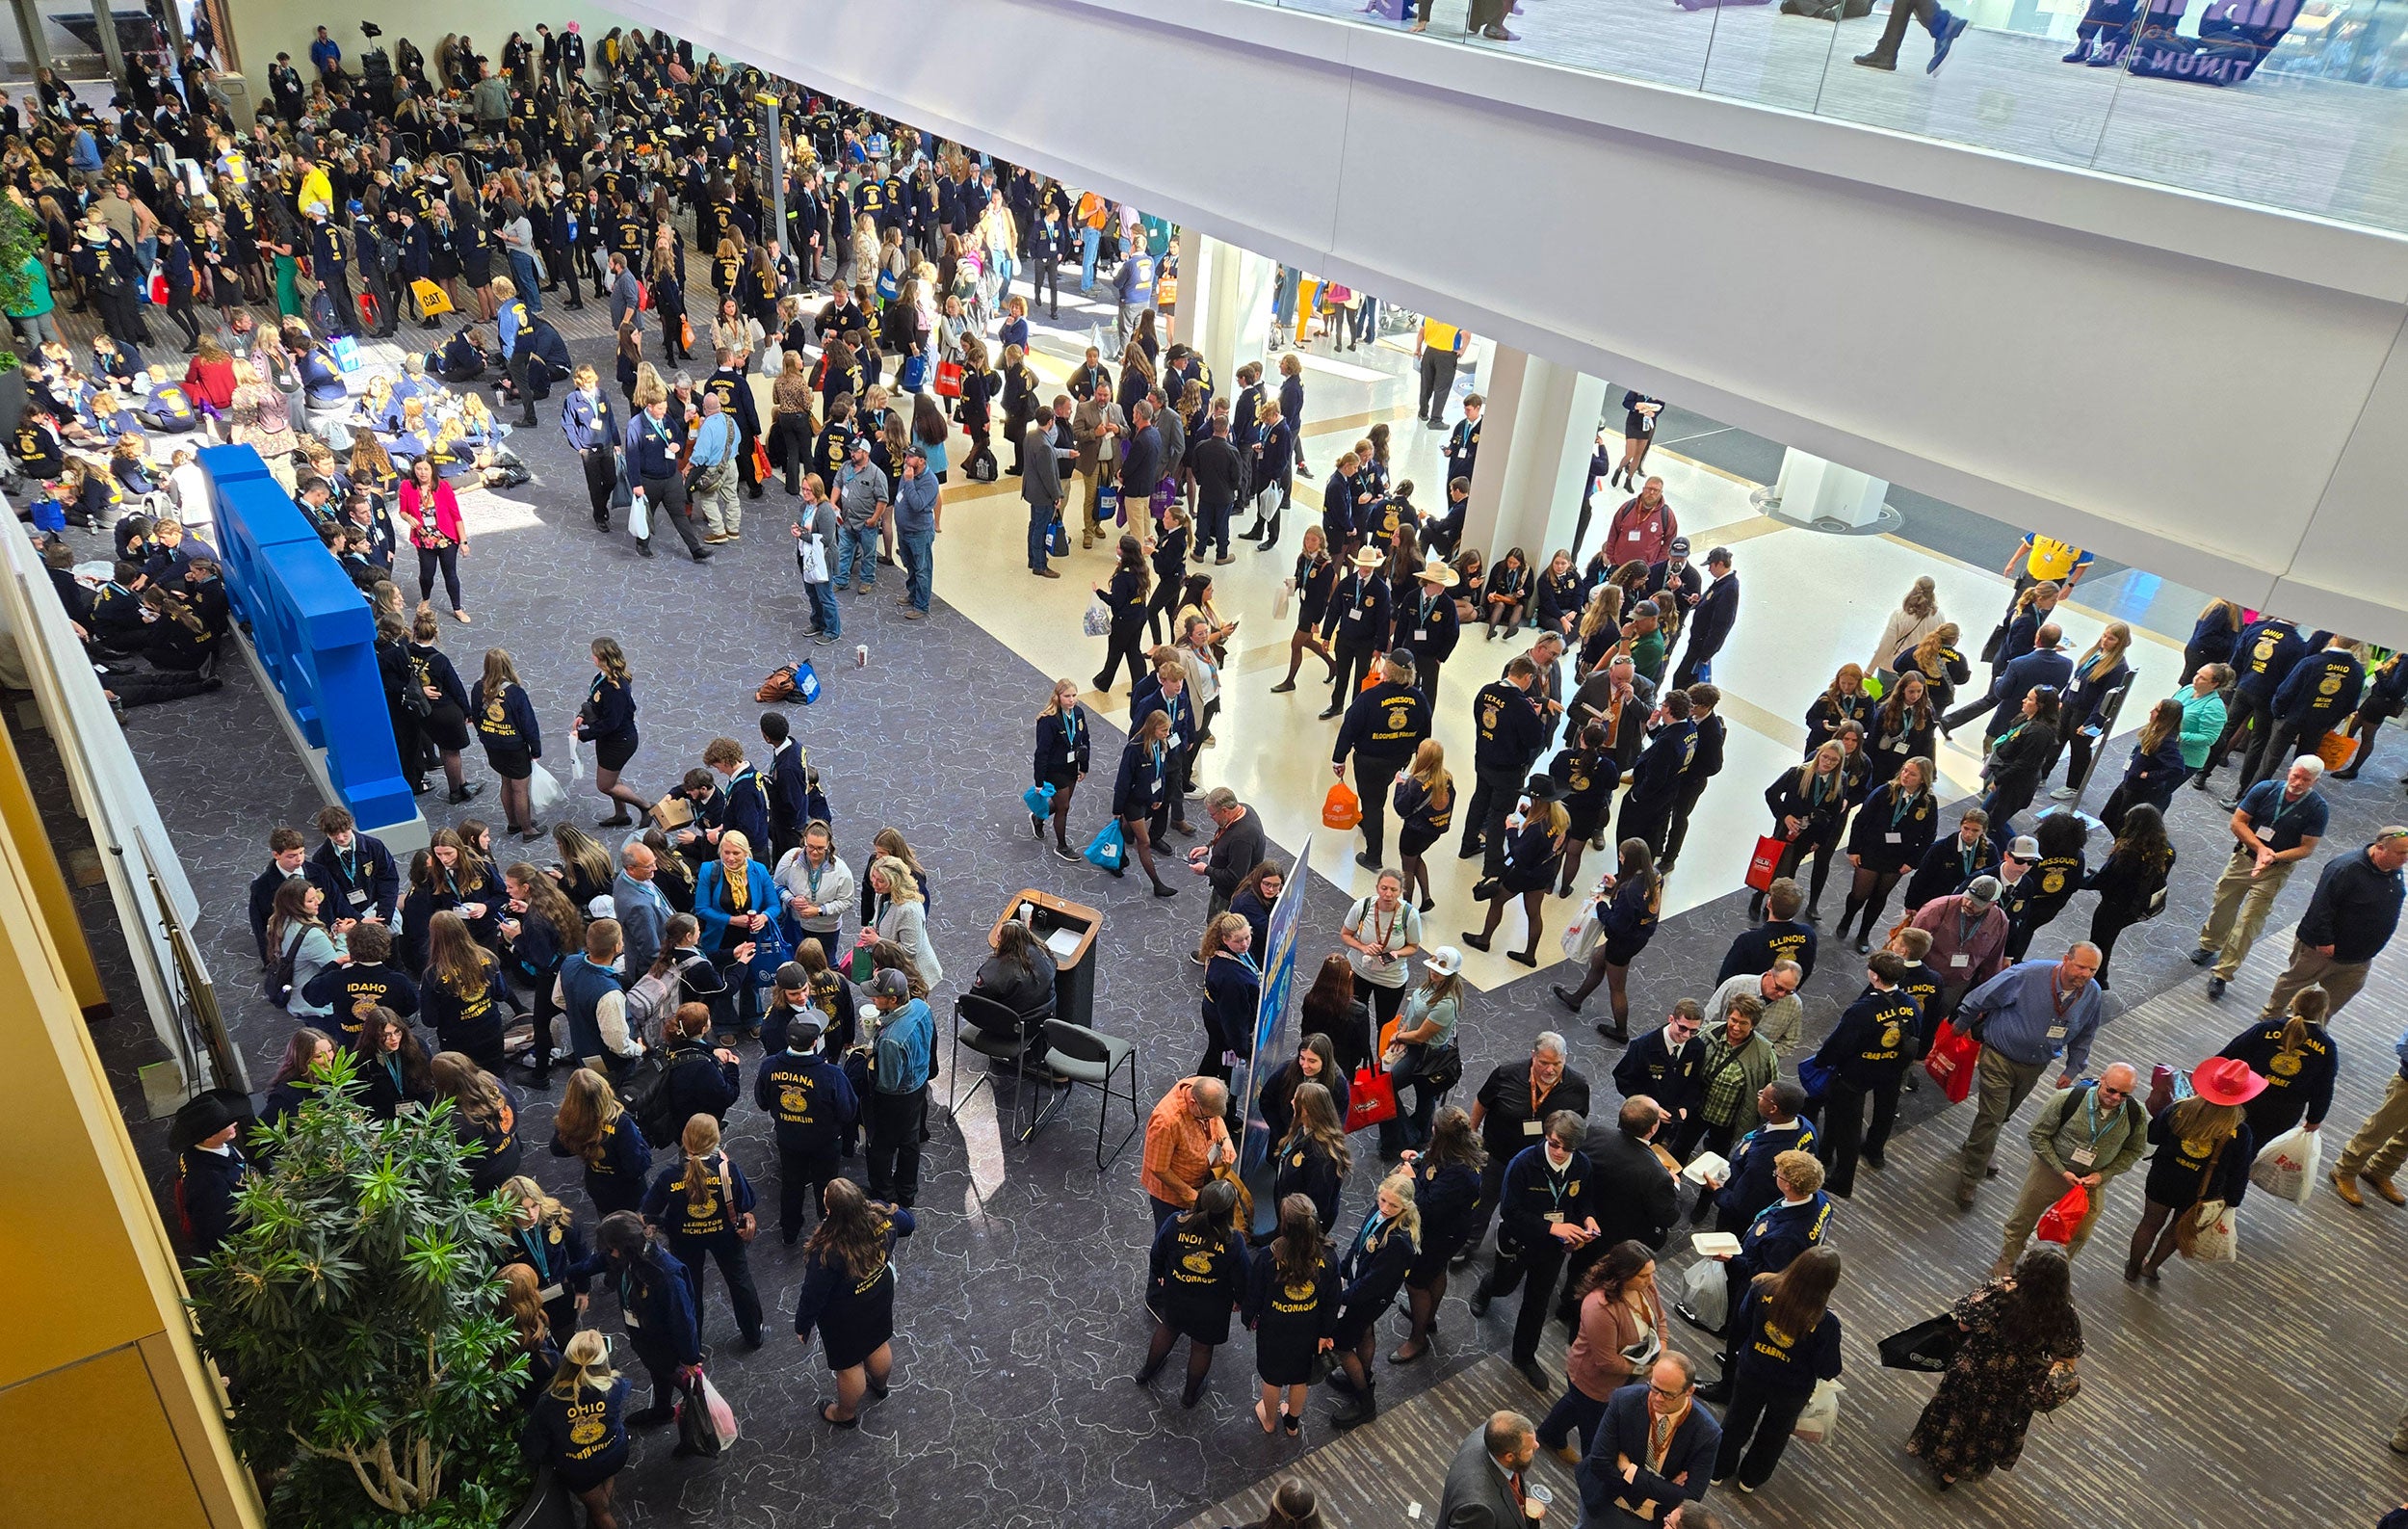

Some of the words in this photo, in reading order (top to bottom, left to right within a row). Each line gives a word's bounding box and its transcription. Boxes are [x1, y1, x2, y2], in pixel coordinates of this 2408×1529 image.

[423, 292, 441, 306] CAT
[2262, 628, 2285, 640] OHIO
[1939, 647, 1960, 662] AHOMA
[2326, 663, 2350, 673] OHIO
[1381, 697, 1416, 708] MINNESOTA
[1484, 694, 1505, 708] TEXAS
[2038, 857, 2079, 868] MISSOURI
[1769, 935, 1807, 949] ILLINOIS
[348, 984, 387, 993] IDAHO
[1900, 984, 1936, 994] LINOIS
[1875, 1006, 1914, 1022] ILLIOIS
[2264, 1030, 2326, 1055] LOANA
[1861, 1050, 1882, 1061] CRAB
[772, 1071, 815, 1089] INDIANA
[2264, 1073, 2291, 1088] GRANT
[779, 1112, 814, 1124] FRANKLIN
[683, 1219, 722, 1227] LEXINGTON
[682, 1226, 718, 1235] RICHLAND
[1178, 1232, 1225, 1253] INDIA
[567, 1401, 606, 1418] OHIO
